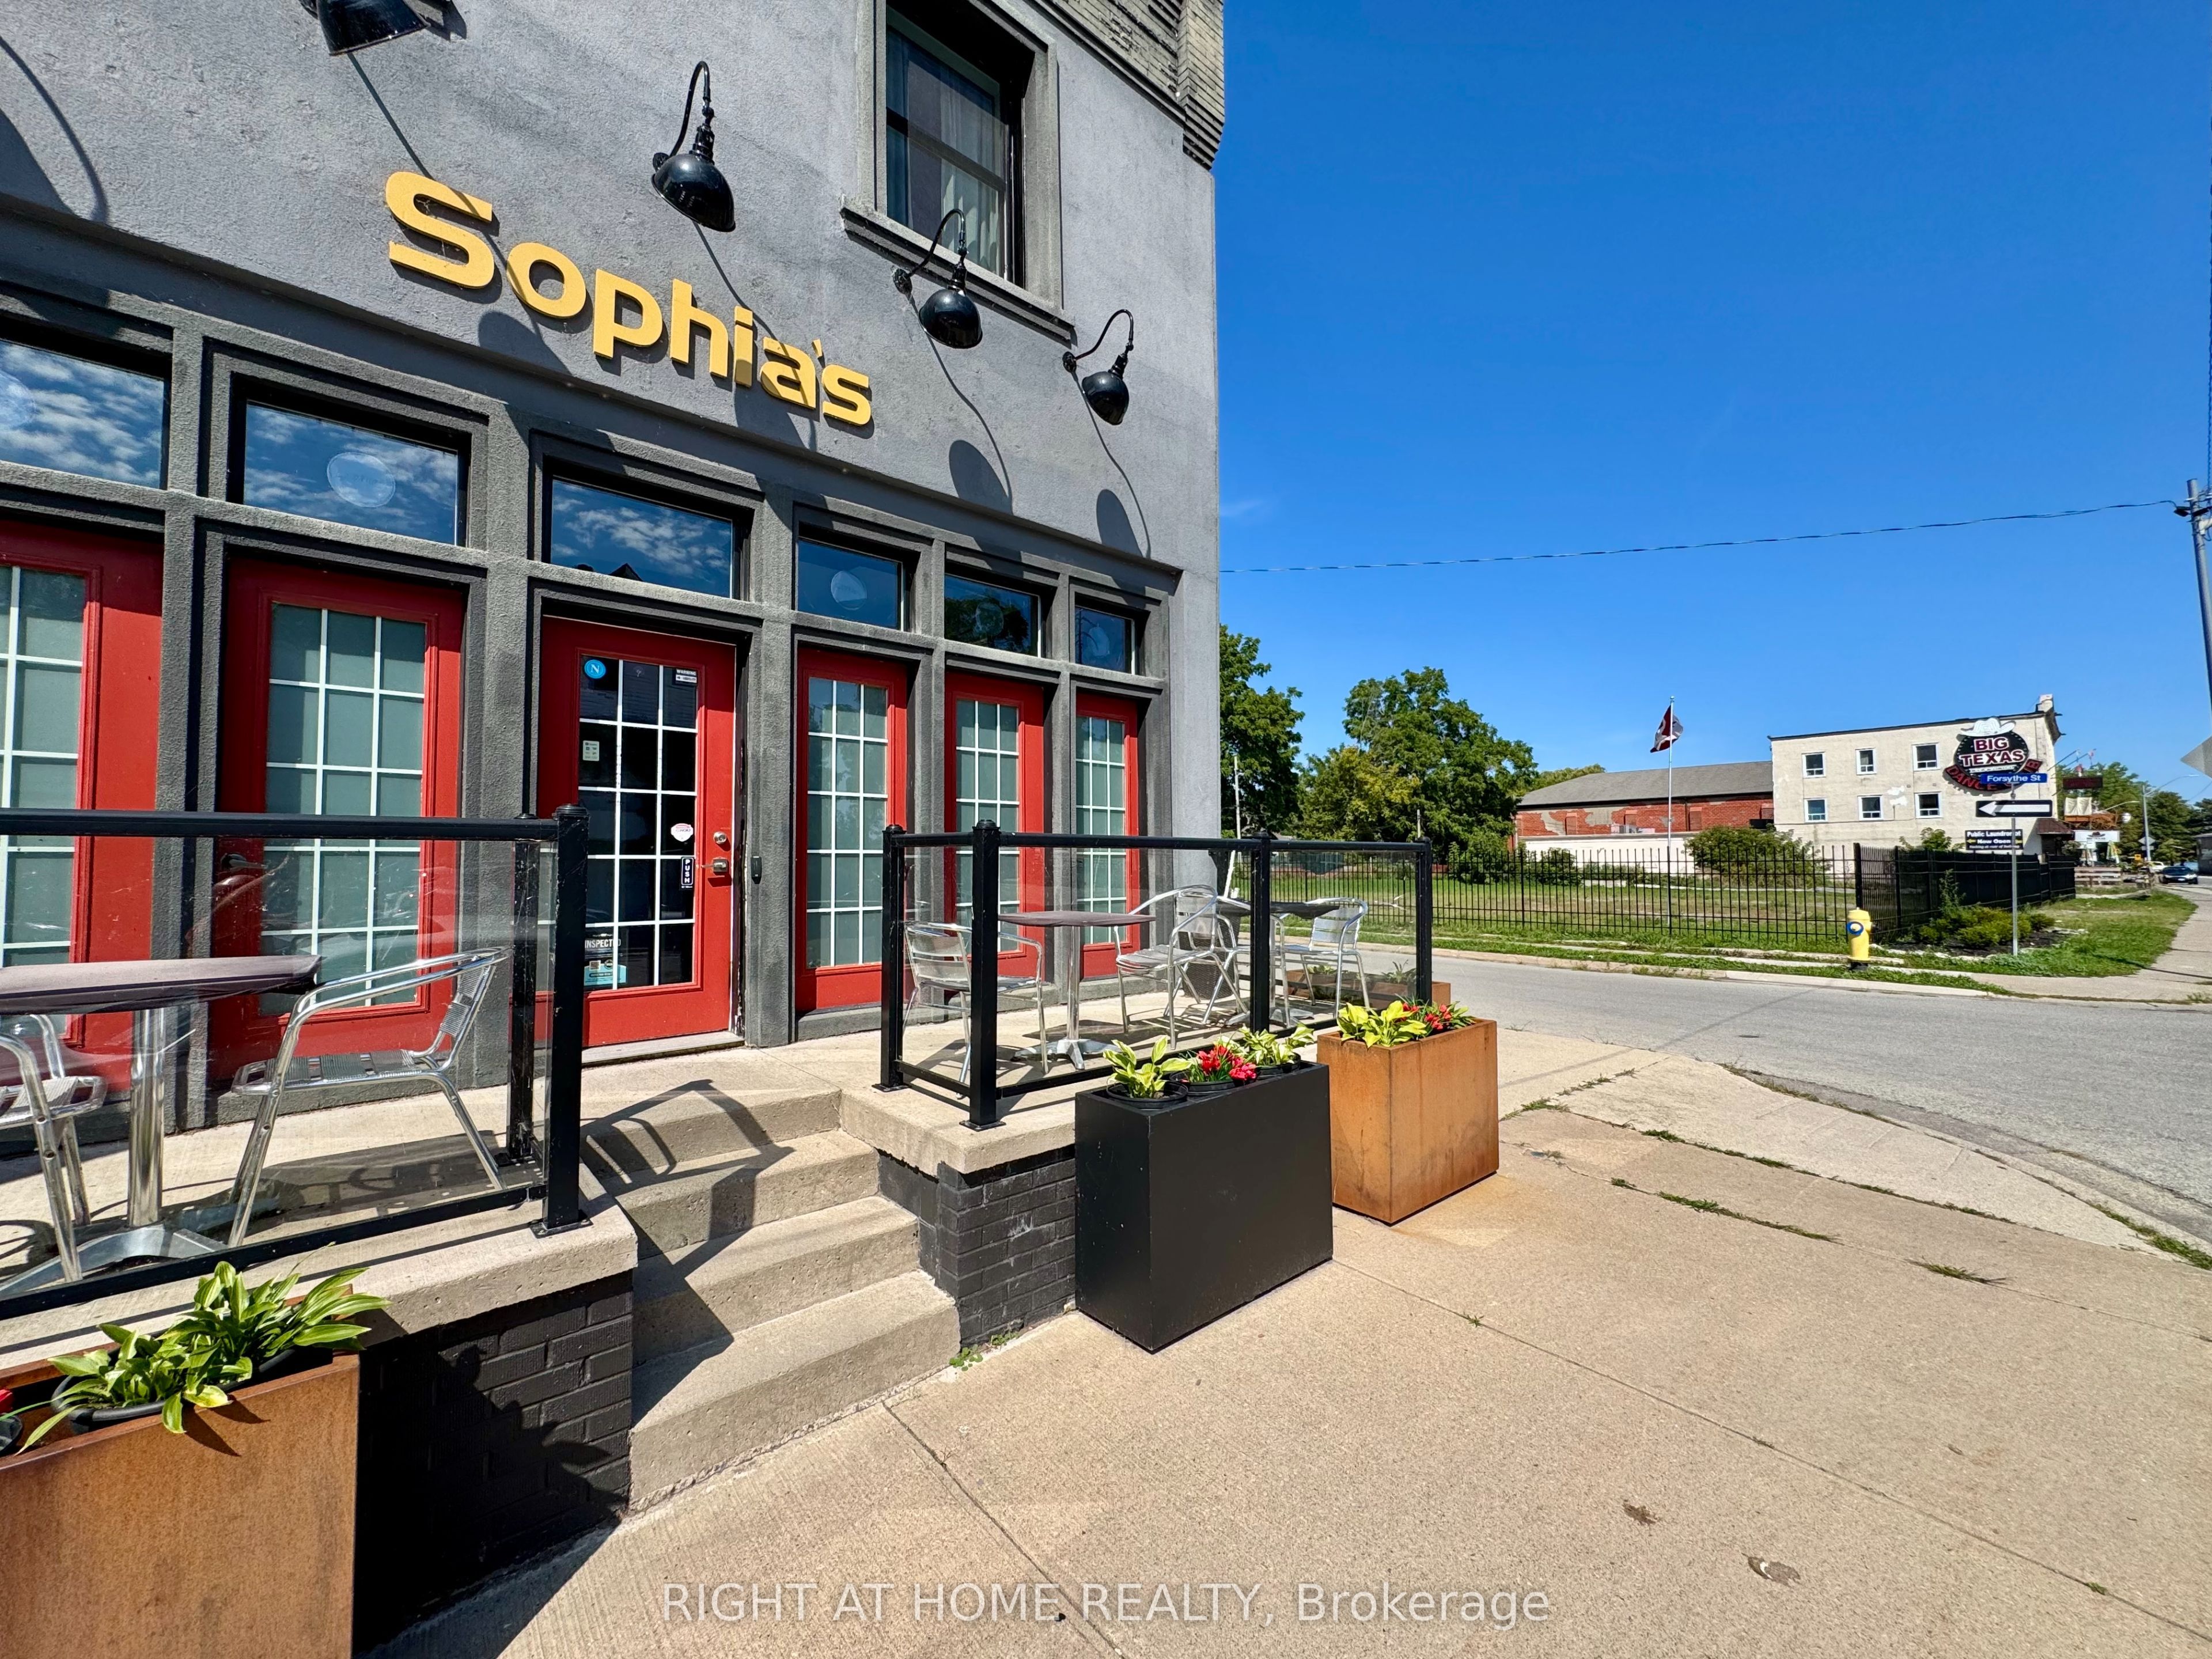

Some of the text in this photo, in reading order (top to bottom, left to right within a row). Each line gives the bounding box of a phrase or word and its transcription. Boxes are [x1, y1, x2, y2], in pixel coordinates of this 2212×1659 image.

[385, 171, 872, 426] Sophia's
[590, 664, 600, 673] N
[1974, 737, 2009, 752] BIG
[1960, 749, 2025, 767] TEXAS
[1987, 775, 2028, 783] Forsythe
[585, 939, 622, 948] INSPECTD
